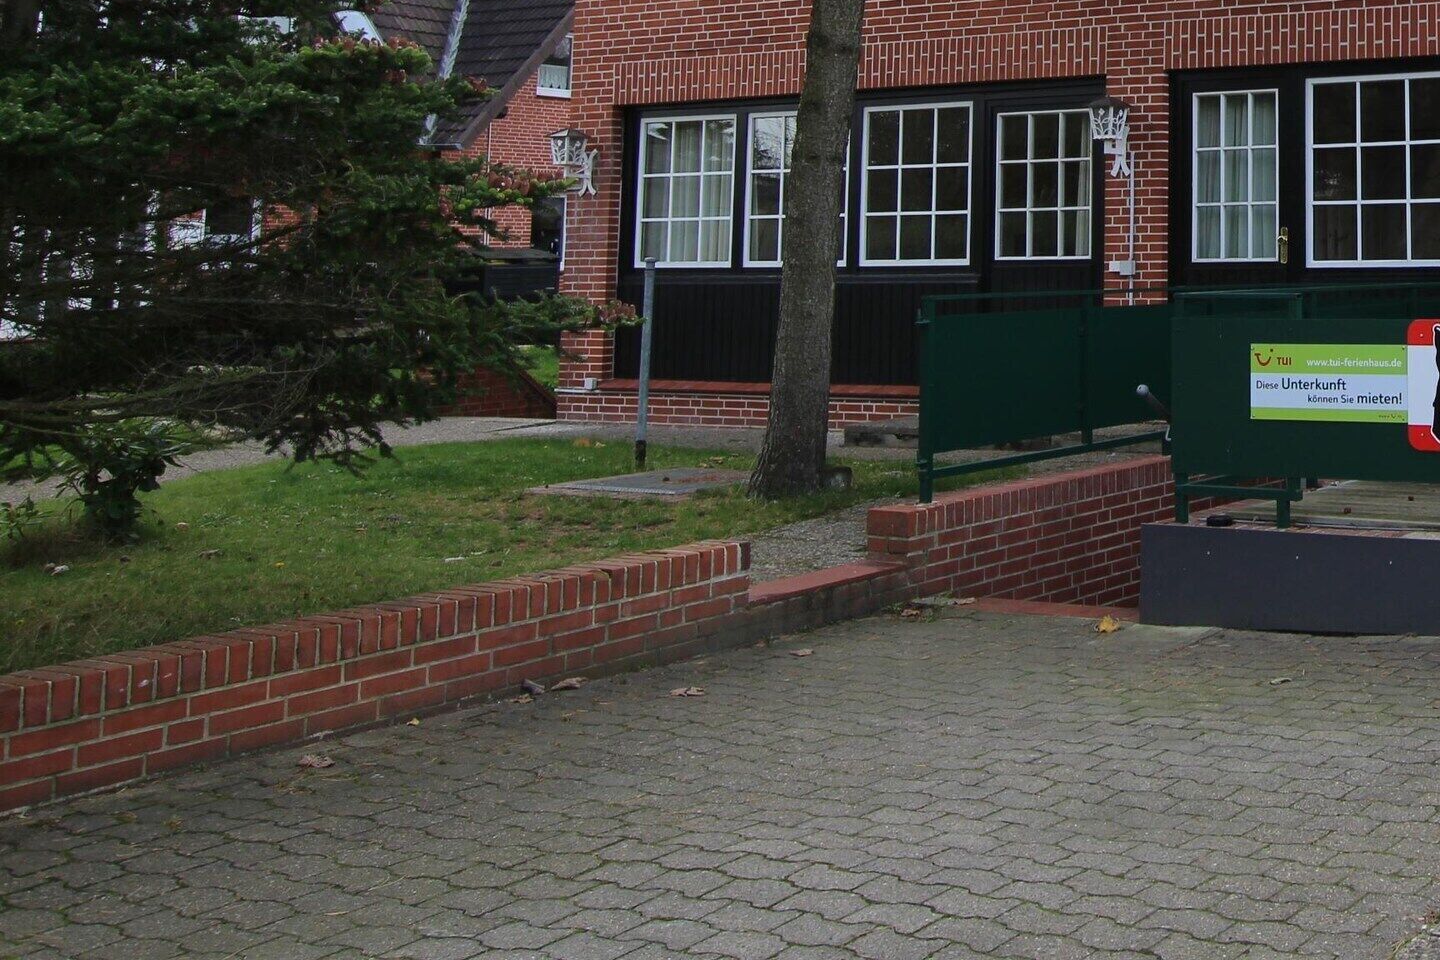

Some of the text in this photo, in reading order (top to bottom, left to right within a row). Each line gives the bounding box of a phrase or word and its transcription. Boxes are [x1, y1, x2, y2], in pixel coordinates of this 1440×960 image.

[1276, 356, 1292, 366] TUI
[1306, 357, 1402, 368] www.tui-ferienhaus.de
[1256, 377, 1347, 391] Diese Unterkunft
[1307, 392, 1402, 405] können Sie mieten!
